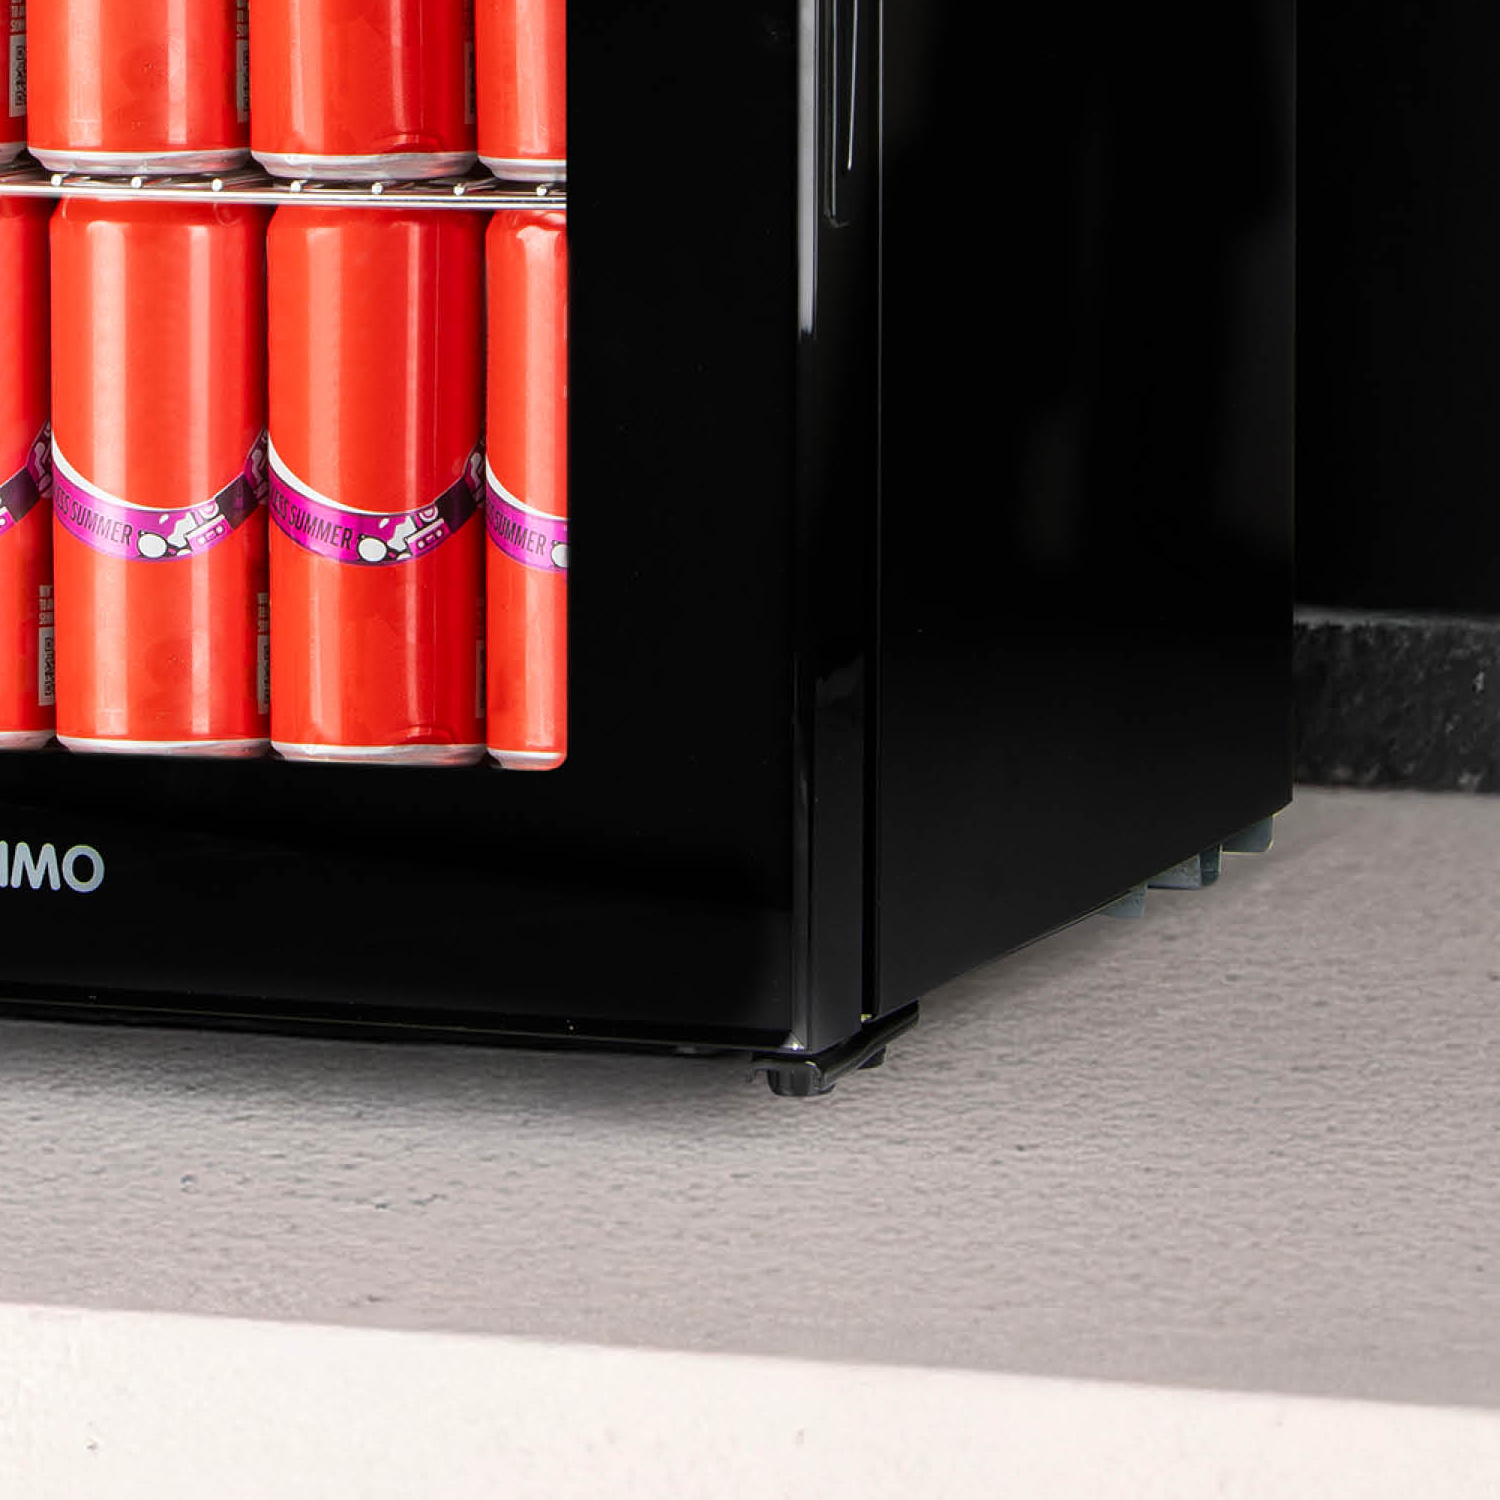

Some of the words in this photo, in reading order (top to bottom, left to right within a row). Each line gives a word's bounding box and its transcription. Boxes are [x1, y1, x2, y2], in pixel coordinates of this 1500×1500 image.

[69, 500, 133, 546] SUMMER
[288, 505, 353, 551] SUMMER
[494, 510, 547, 557] SUMMER
